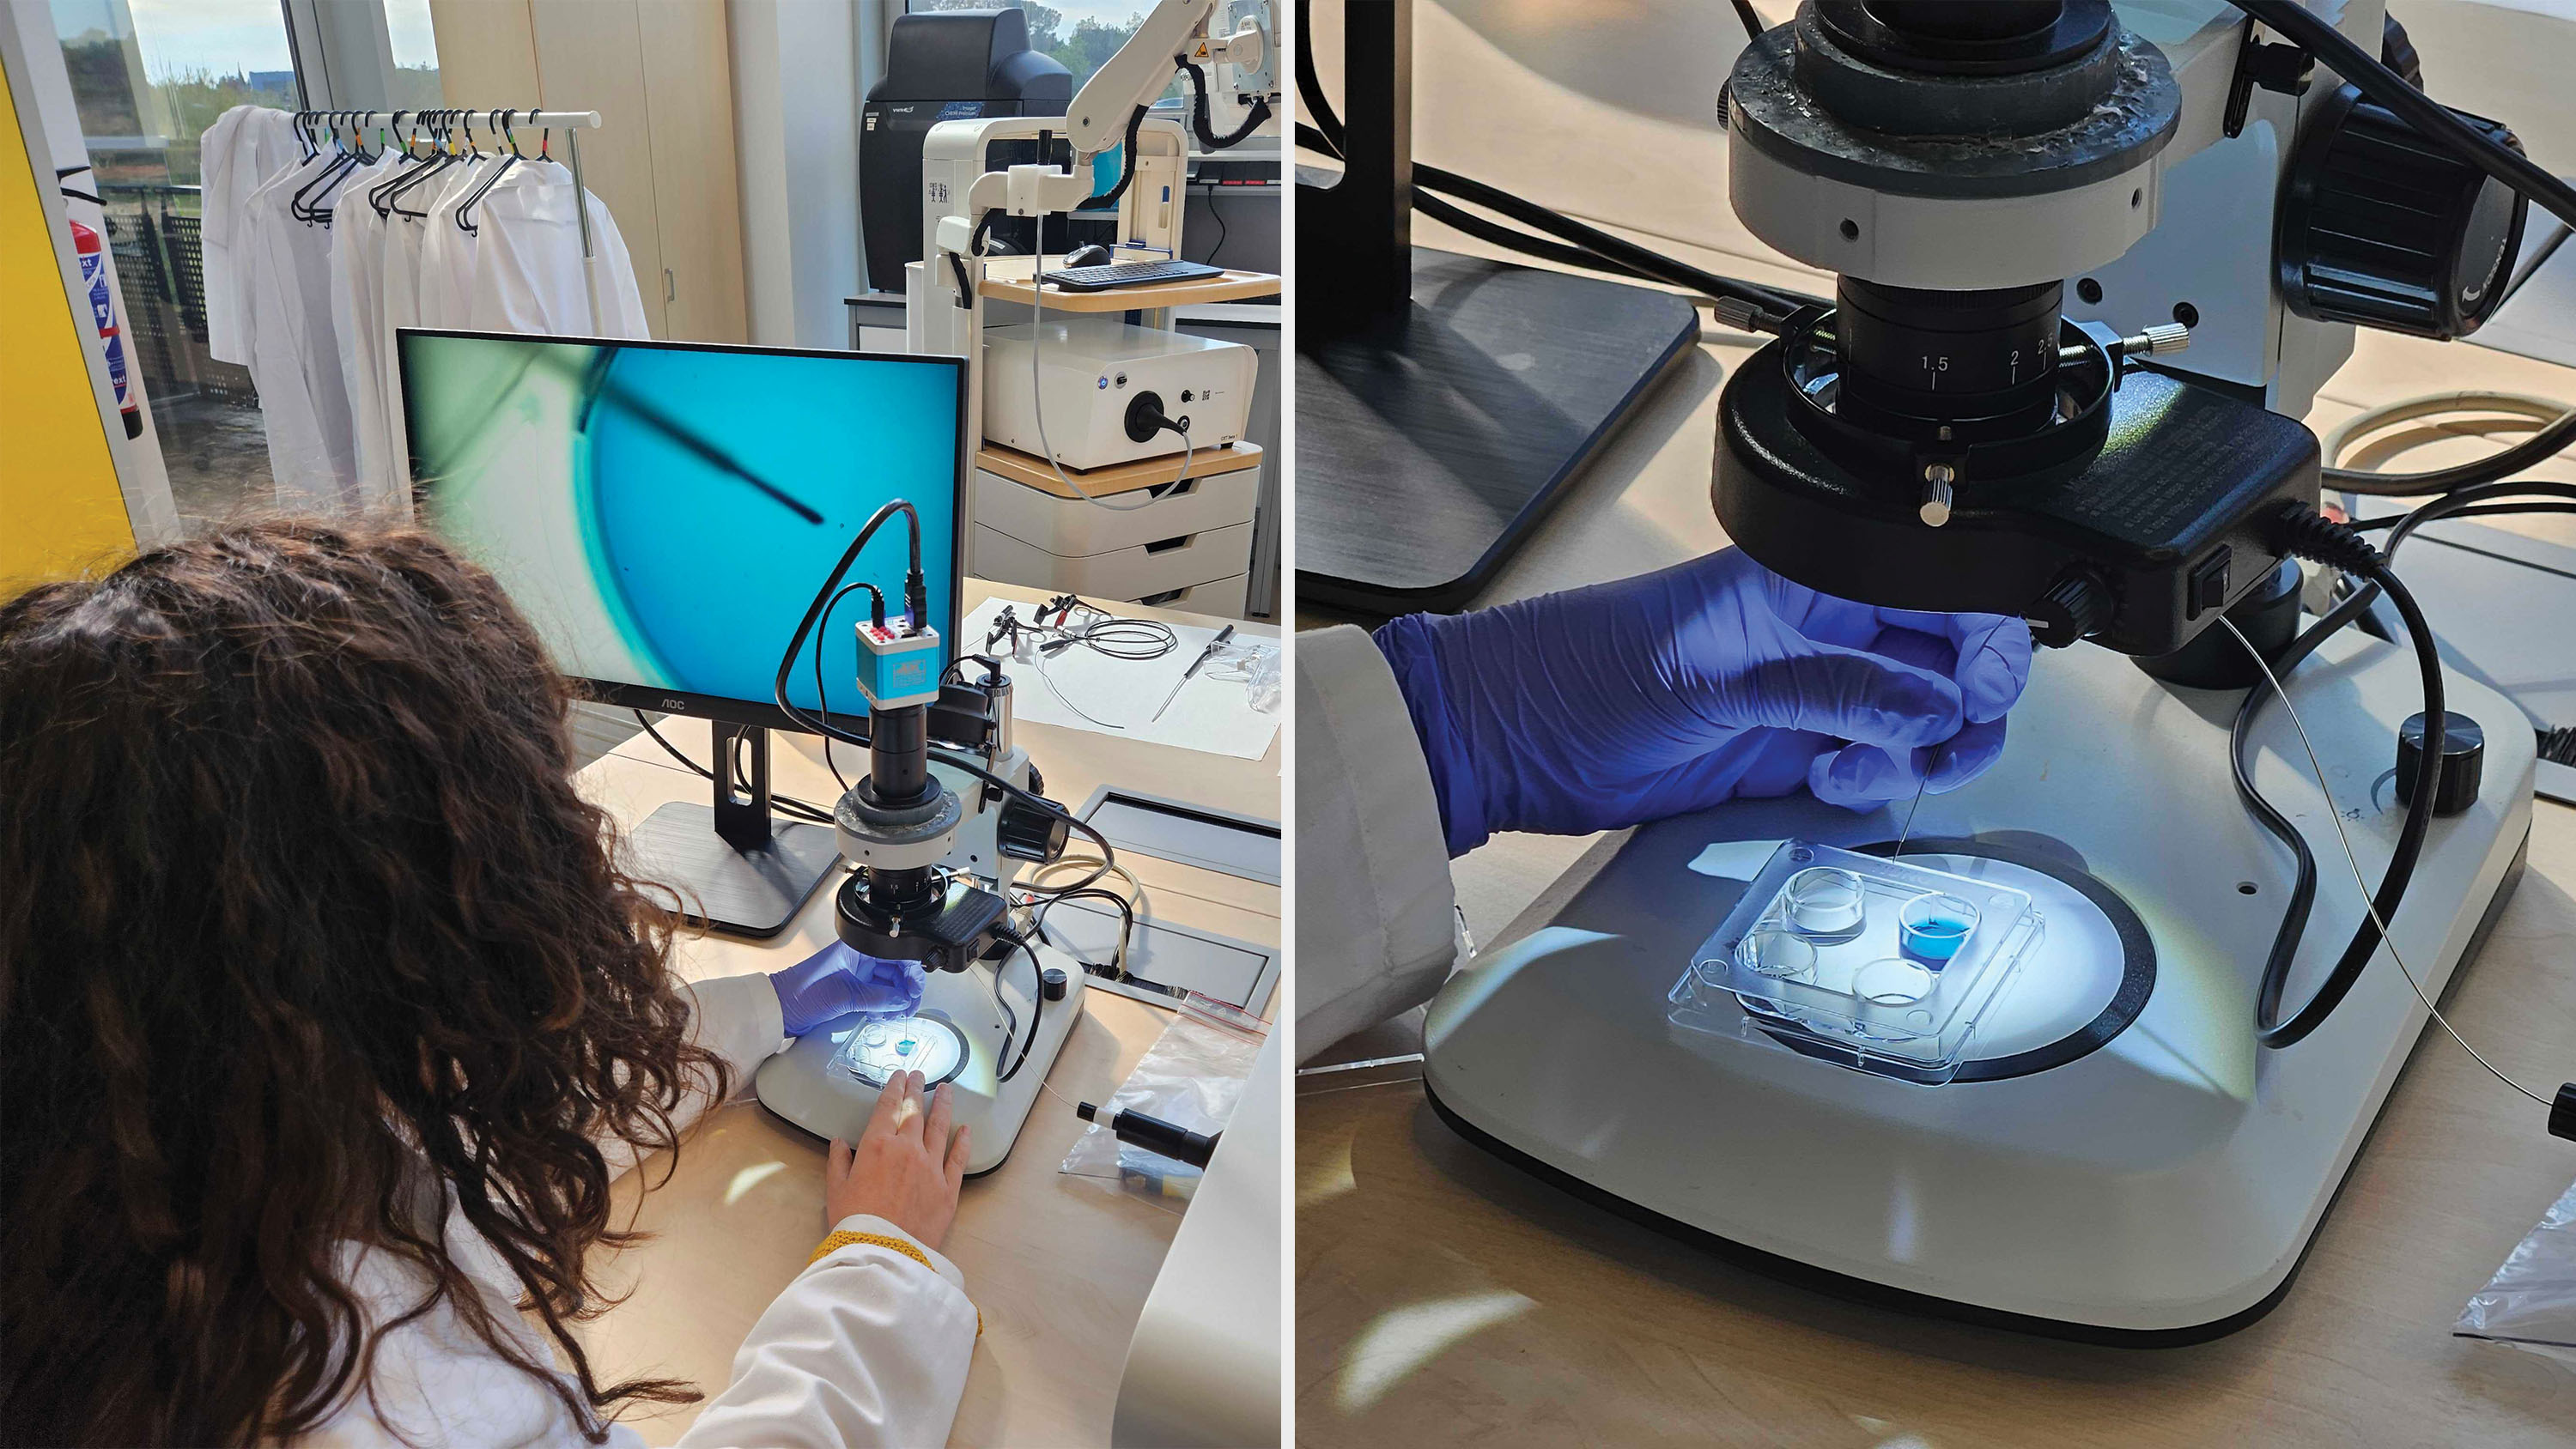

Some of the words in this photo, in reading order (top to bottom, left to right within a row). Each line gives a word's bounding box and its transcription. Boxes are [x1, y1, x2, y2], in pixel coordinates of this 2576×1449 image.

[2038, 332, 2053, 355] 2.5
[1922, 355, 1948, 372] 1.5
[2010, 350, 2019, 366] 2
[661, 699, 685, 710] AOC
